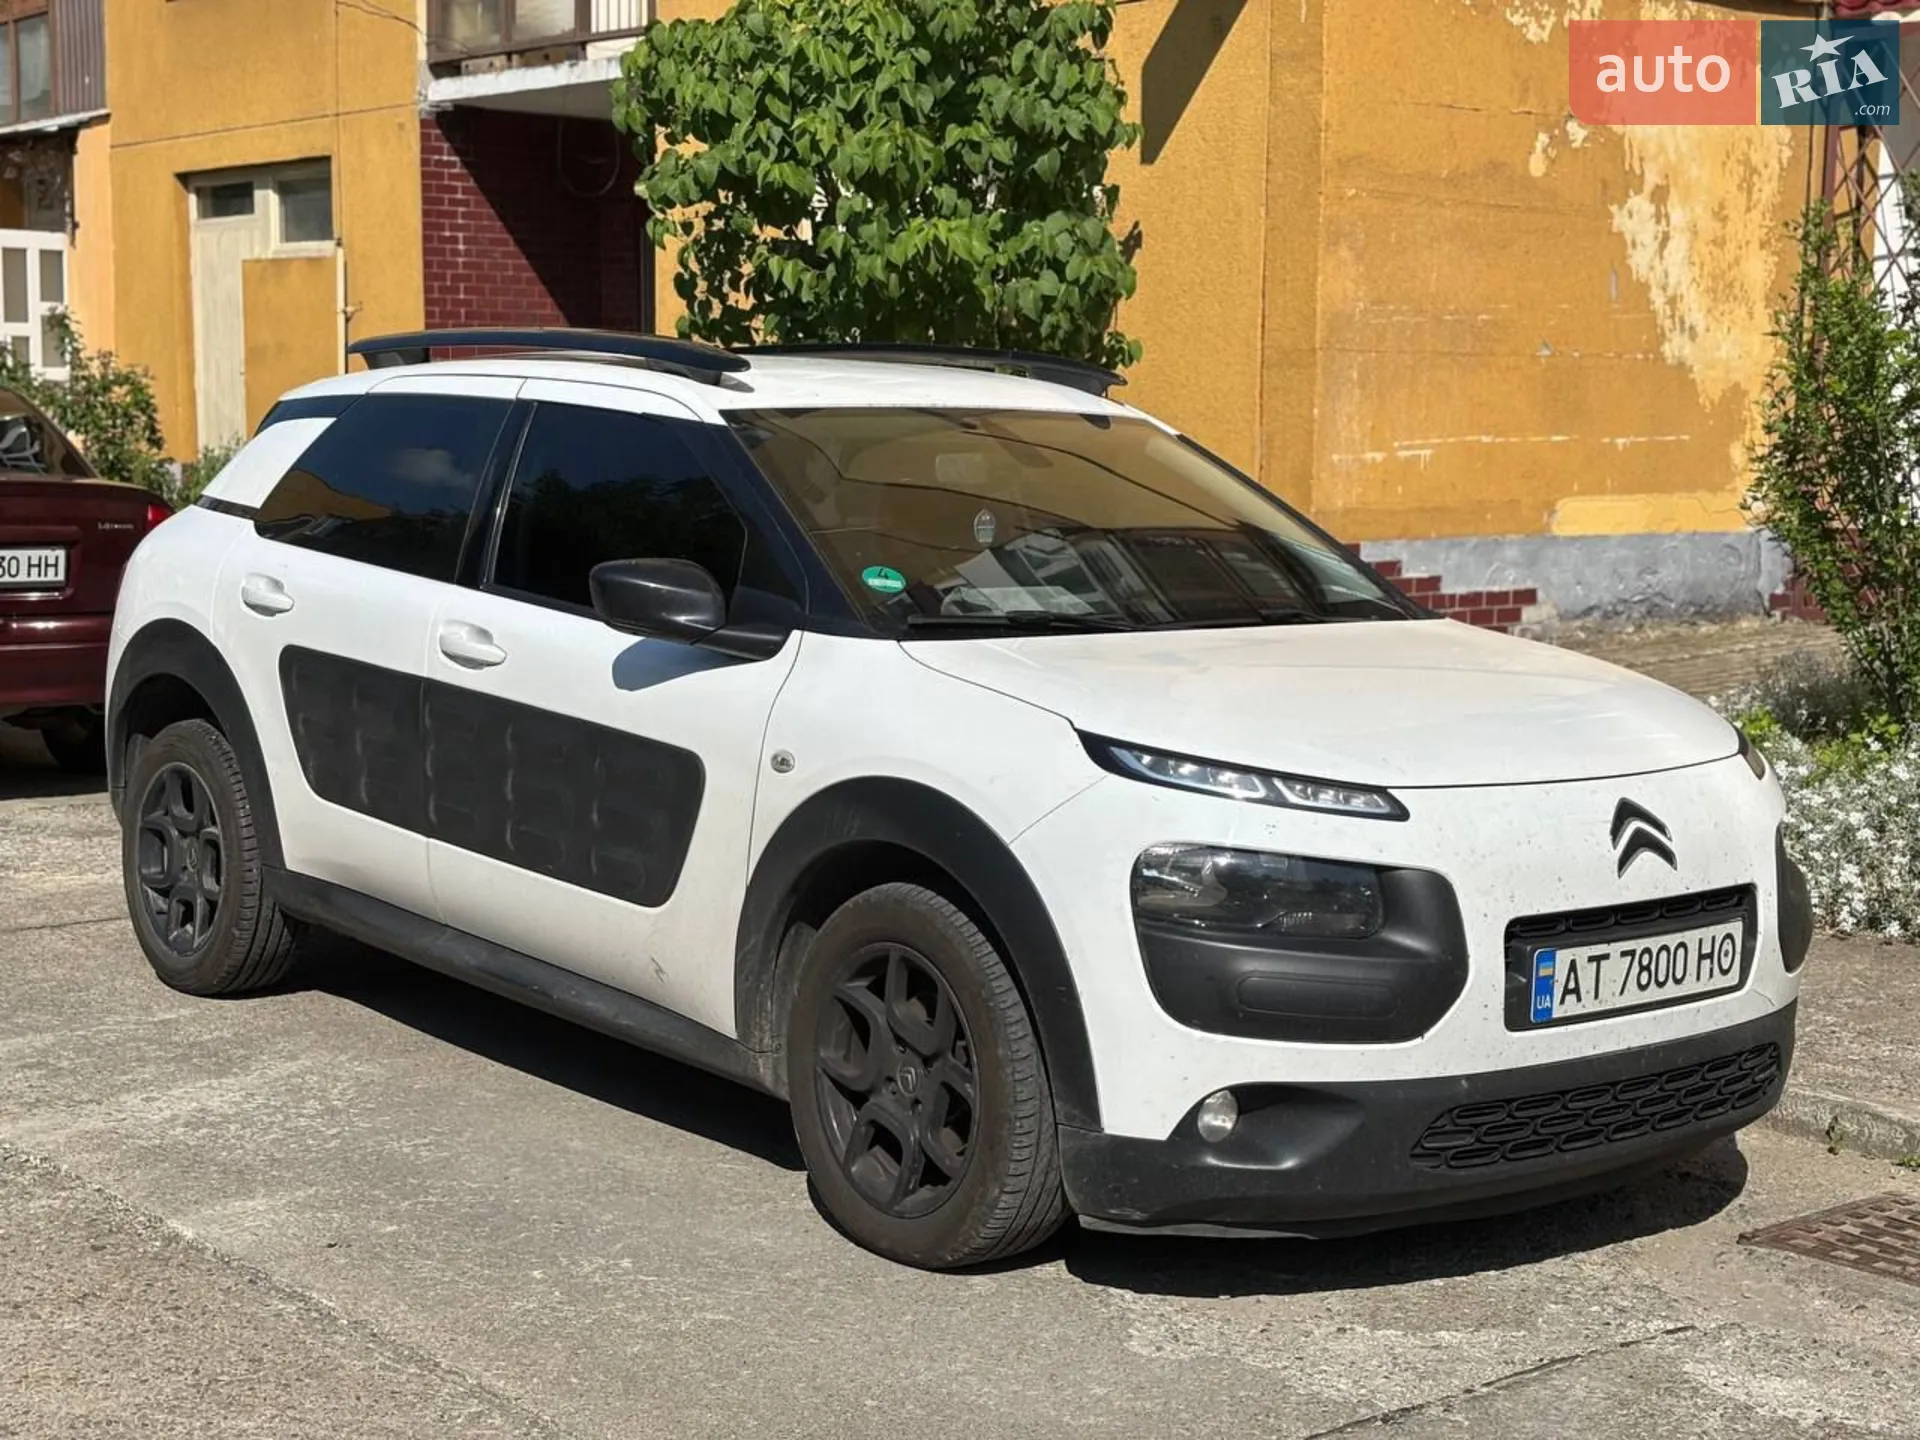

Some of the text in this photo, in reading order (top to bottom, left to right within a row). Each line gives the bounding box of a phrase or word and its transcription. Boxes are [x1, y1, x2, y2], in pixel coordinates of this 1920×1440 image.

[27, 555, 59, 578] HH
[877, 568, 889, 579] 4
[1558, 932, 1737, 1006] AT 7800 HO
[1536, 994, 1552, 1010] UA
